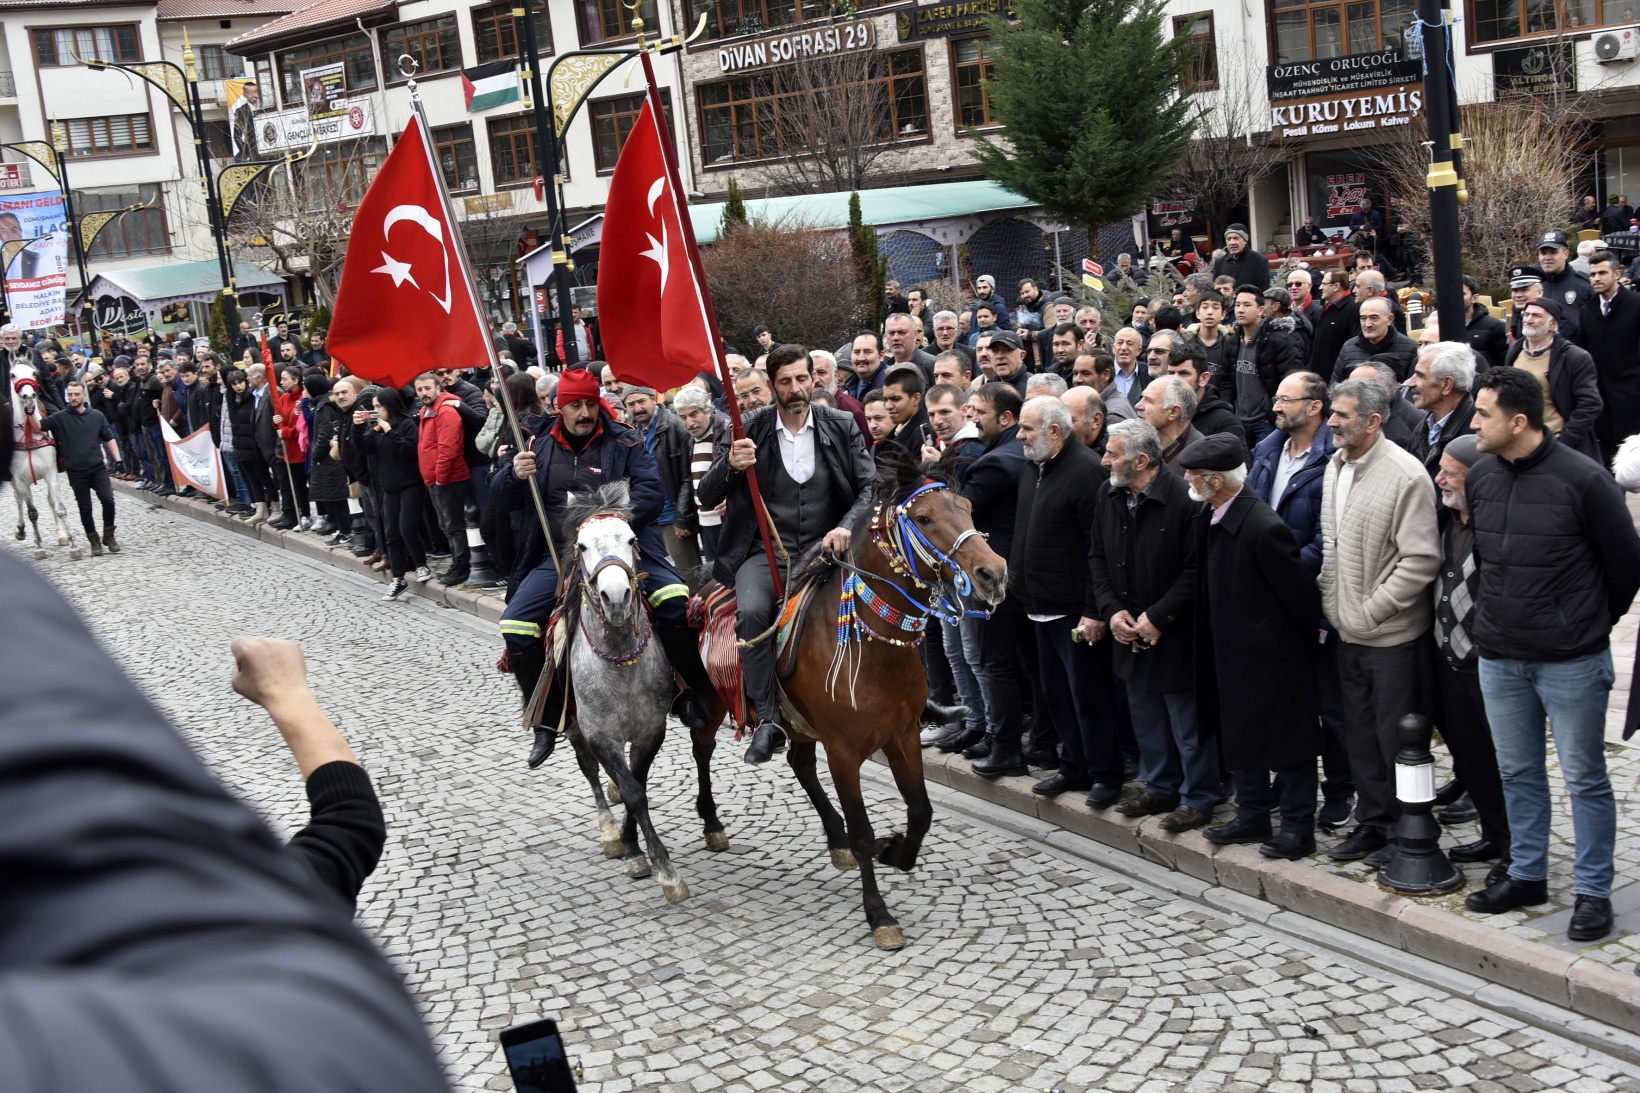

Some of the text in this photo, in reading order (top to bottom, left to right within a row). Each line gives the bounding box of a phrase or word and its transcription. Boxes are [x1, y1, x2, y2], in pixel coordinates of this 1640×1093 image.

[917, 6, 954, 23] ZAFER
[769, 28, 842, 63] SOFRASI
[1274, 50, 1401, 79] ÖZENÇ ORUÇOĞL
[1293, 76, 1338, 88] MÜHENDİSLİK
[1350, 69, 1393, 81] MÜŞAVİRLİK
[1272, 89, 1297, 99] İNŞAAT
[1298, 85, 1329, 95] TAAHHÜT
[1330, 82, 1359, 92] TİCARET
[1271, 86, 1422, 127] KURUYEMİŞ
[1283, 127, 1308, 138] Pestil
[1344, 119, 1375, 131] Lokum
[1381, 115, 1410, 127] Kahve
[1327, 172, 1365, 185] EREN
[42, 275, 66, 286] GÜMÜŞ
[33, 290, 60, 300] HALKIN
[15, 299, 50, 309] BELEDİYE
[40, 306, 61, 316] ADAYI
[30, 315, 52, 327] BEDRİ
